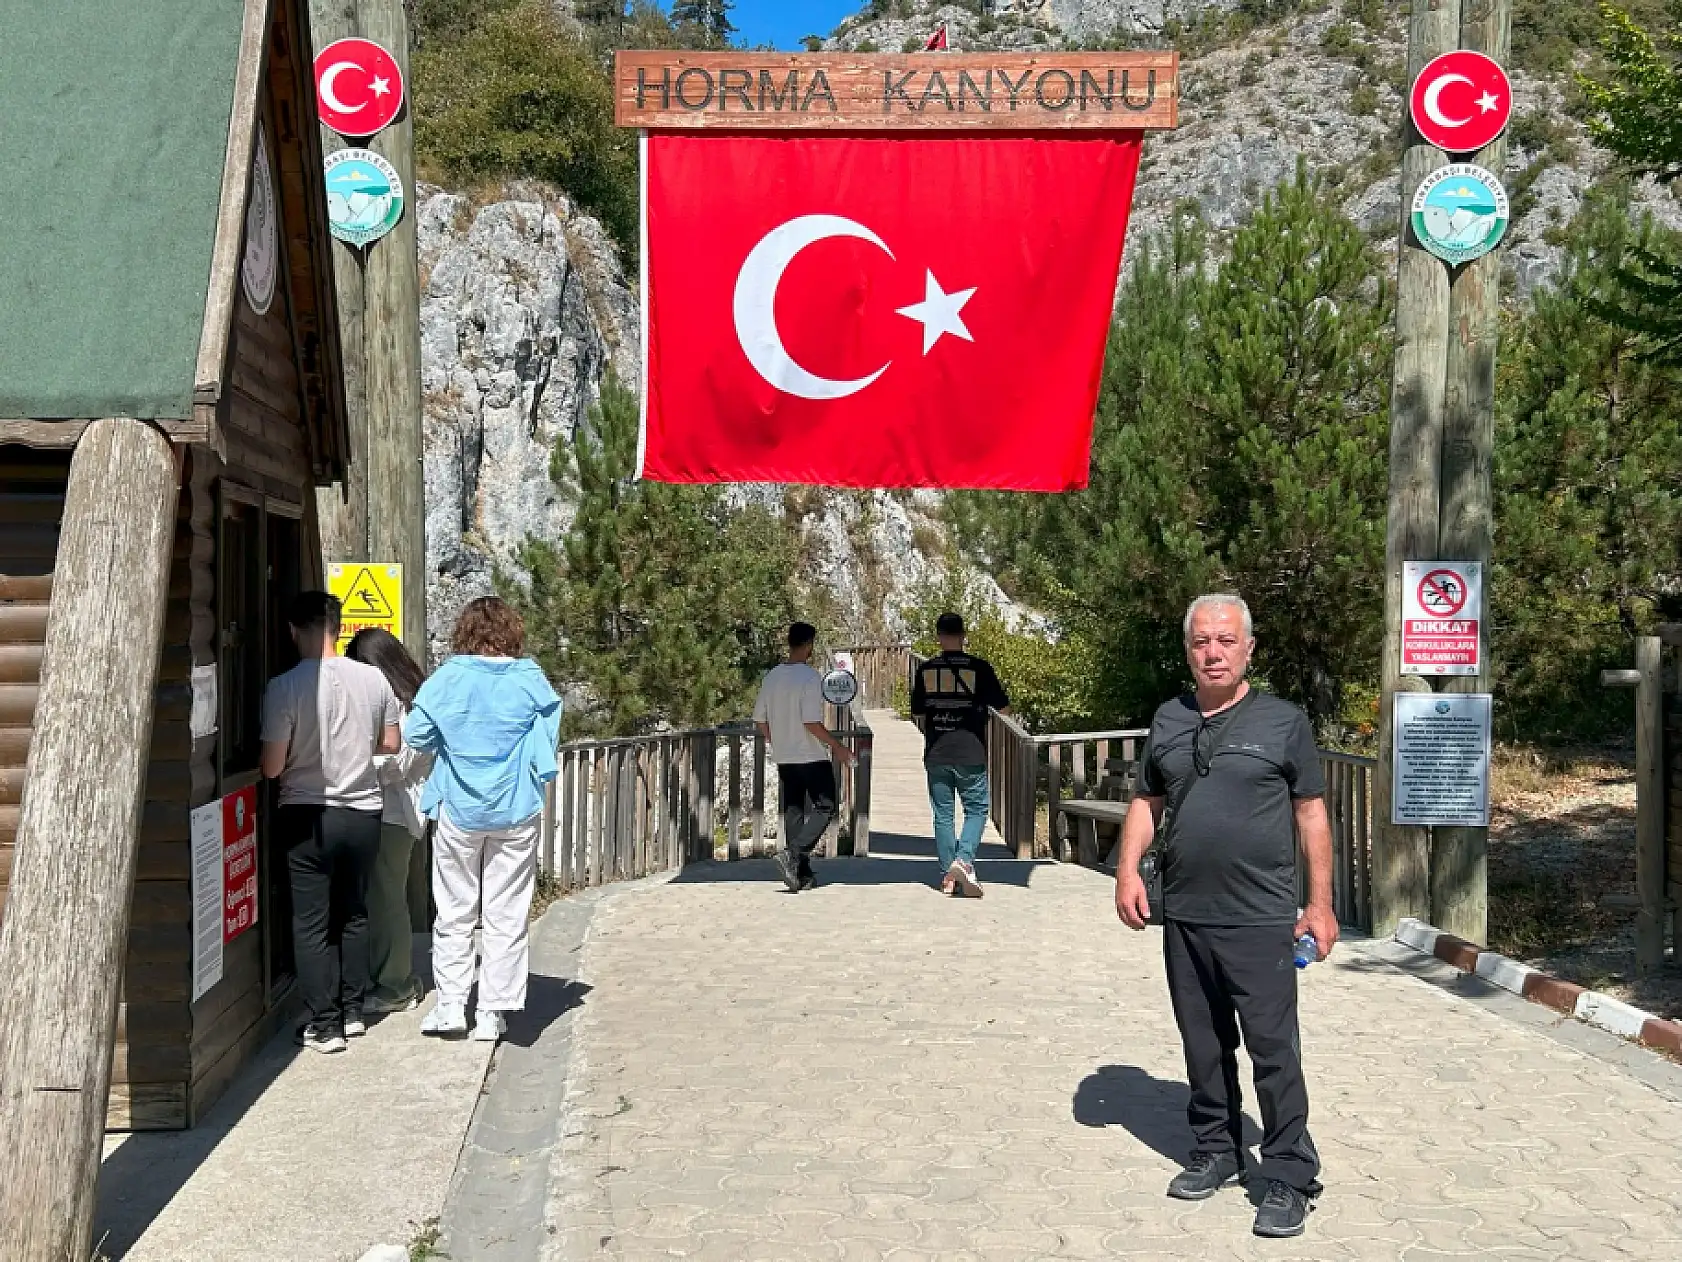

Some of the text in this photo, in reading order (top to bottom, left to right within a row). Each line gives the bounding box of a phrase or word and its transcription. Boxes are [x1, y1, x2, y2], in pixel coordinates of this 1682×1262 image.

[636, 67, 1157, 112] HORMA KANYONU
[1405, 641, 1475, 651] KORKULUKLARA
